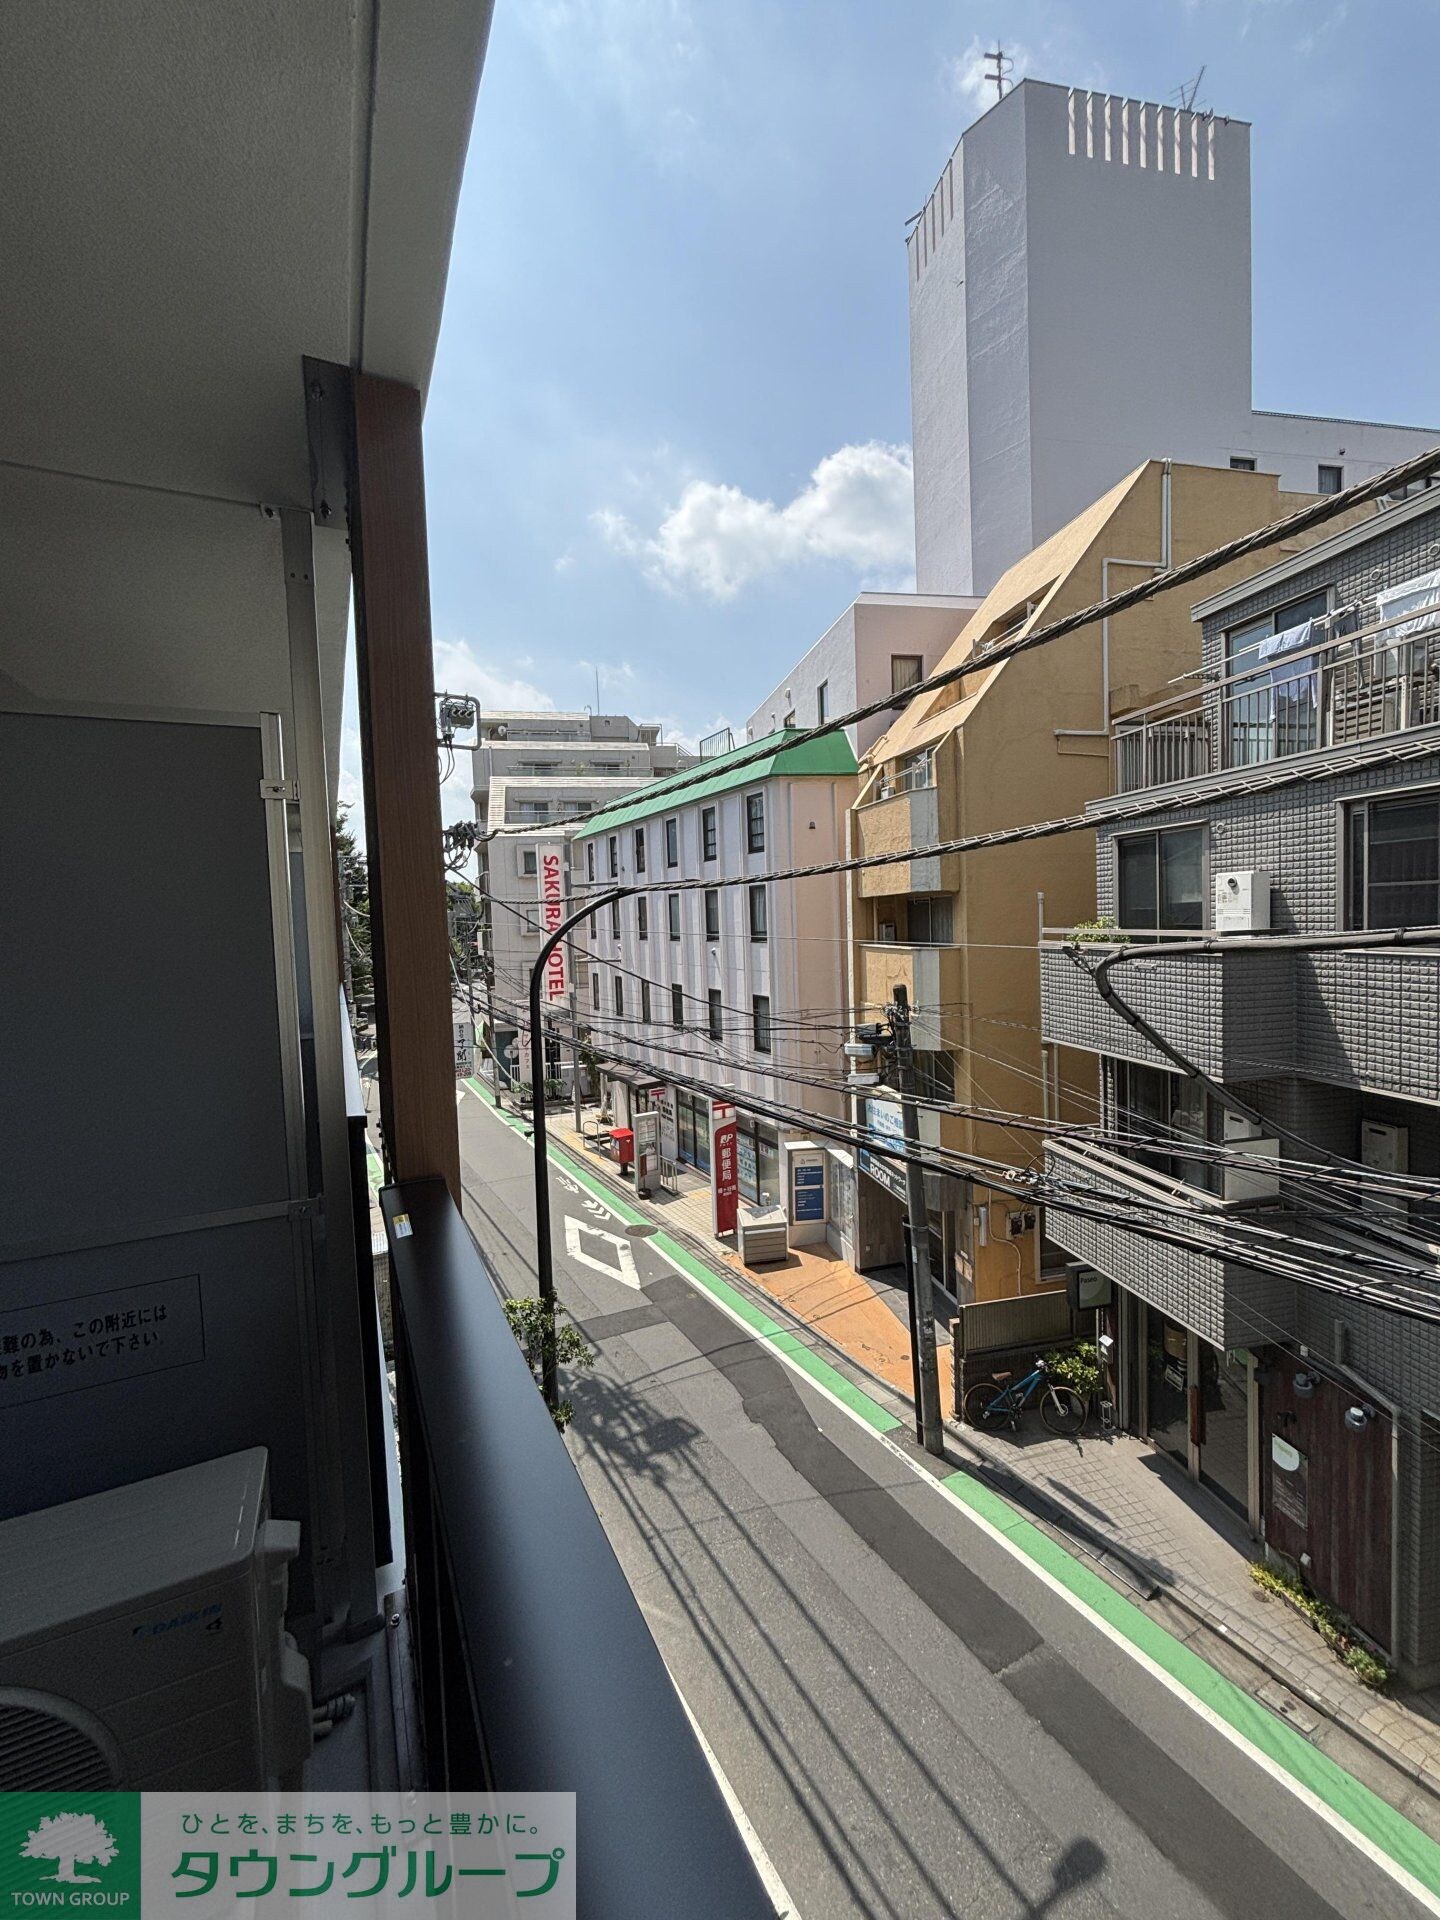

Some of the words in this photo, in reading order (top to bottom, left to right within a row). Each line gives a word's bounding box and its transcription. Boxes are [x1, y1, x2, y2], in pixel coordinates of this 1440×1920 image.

[543, 855, 561, 934] SAKURA
[721, 1147, 732, 1182] 郵便局
[869, 1163, 891, 1188] ROOM
[0, 1304, 168, 1355] 難の為、この附近には
